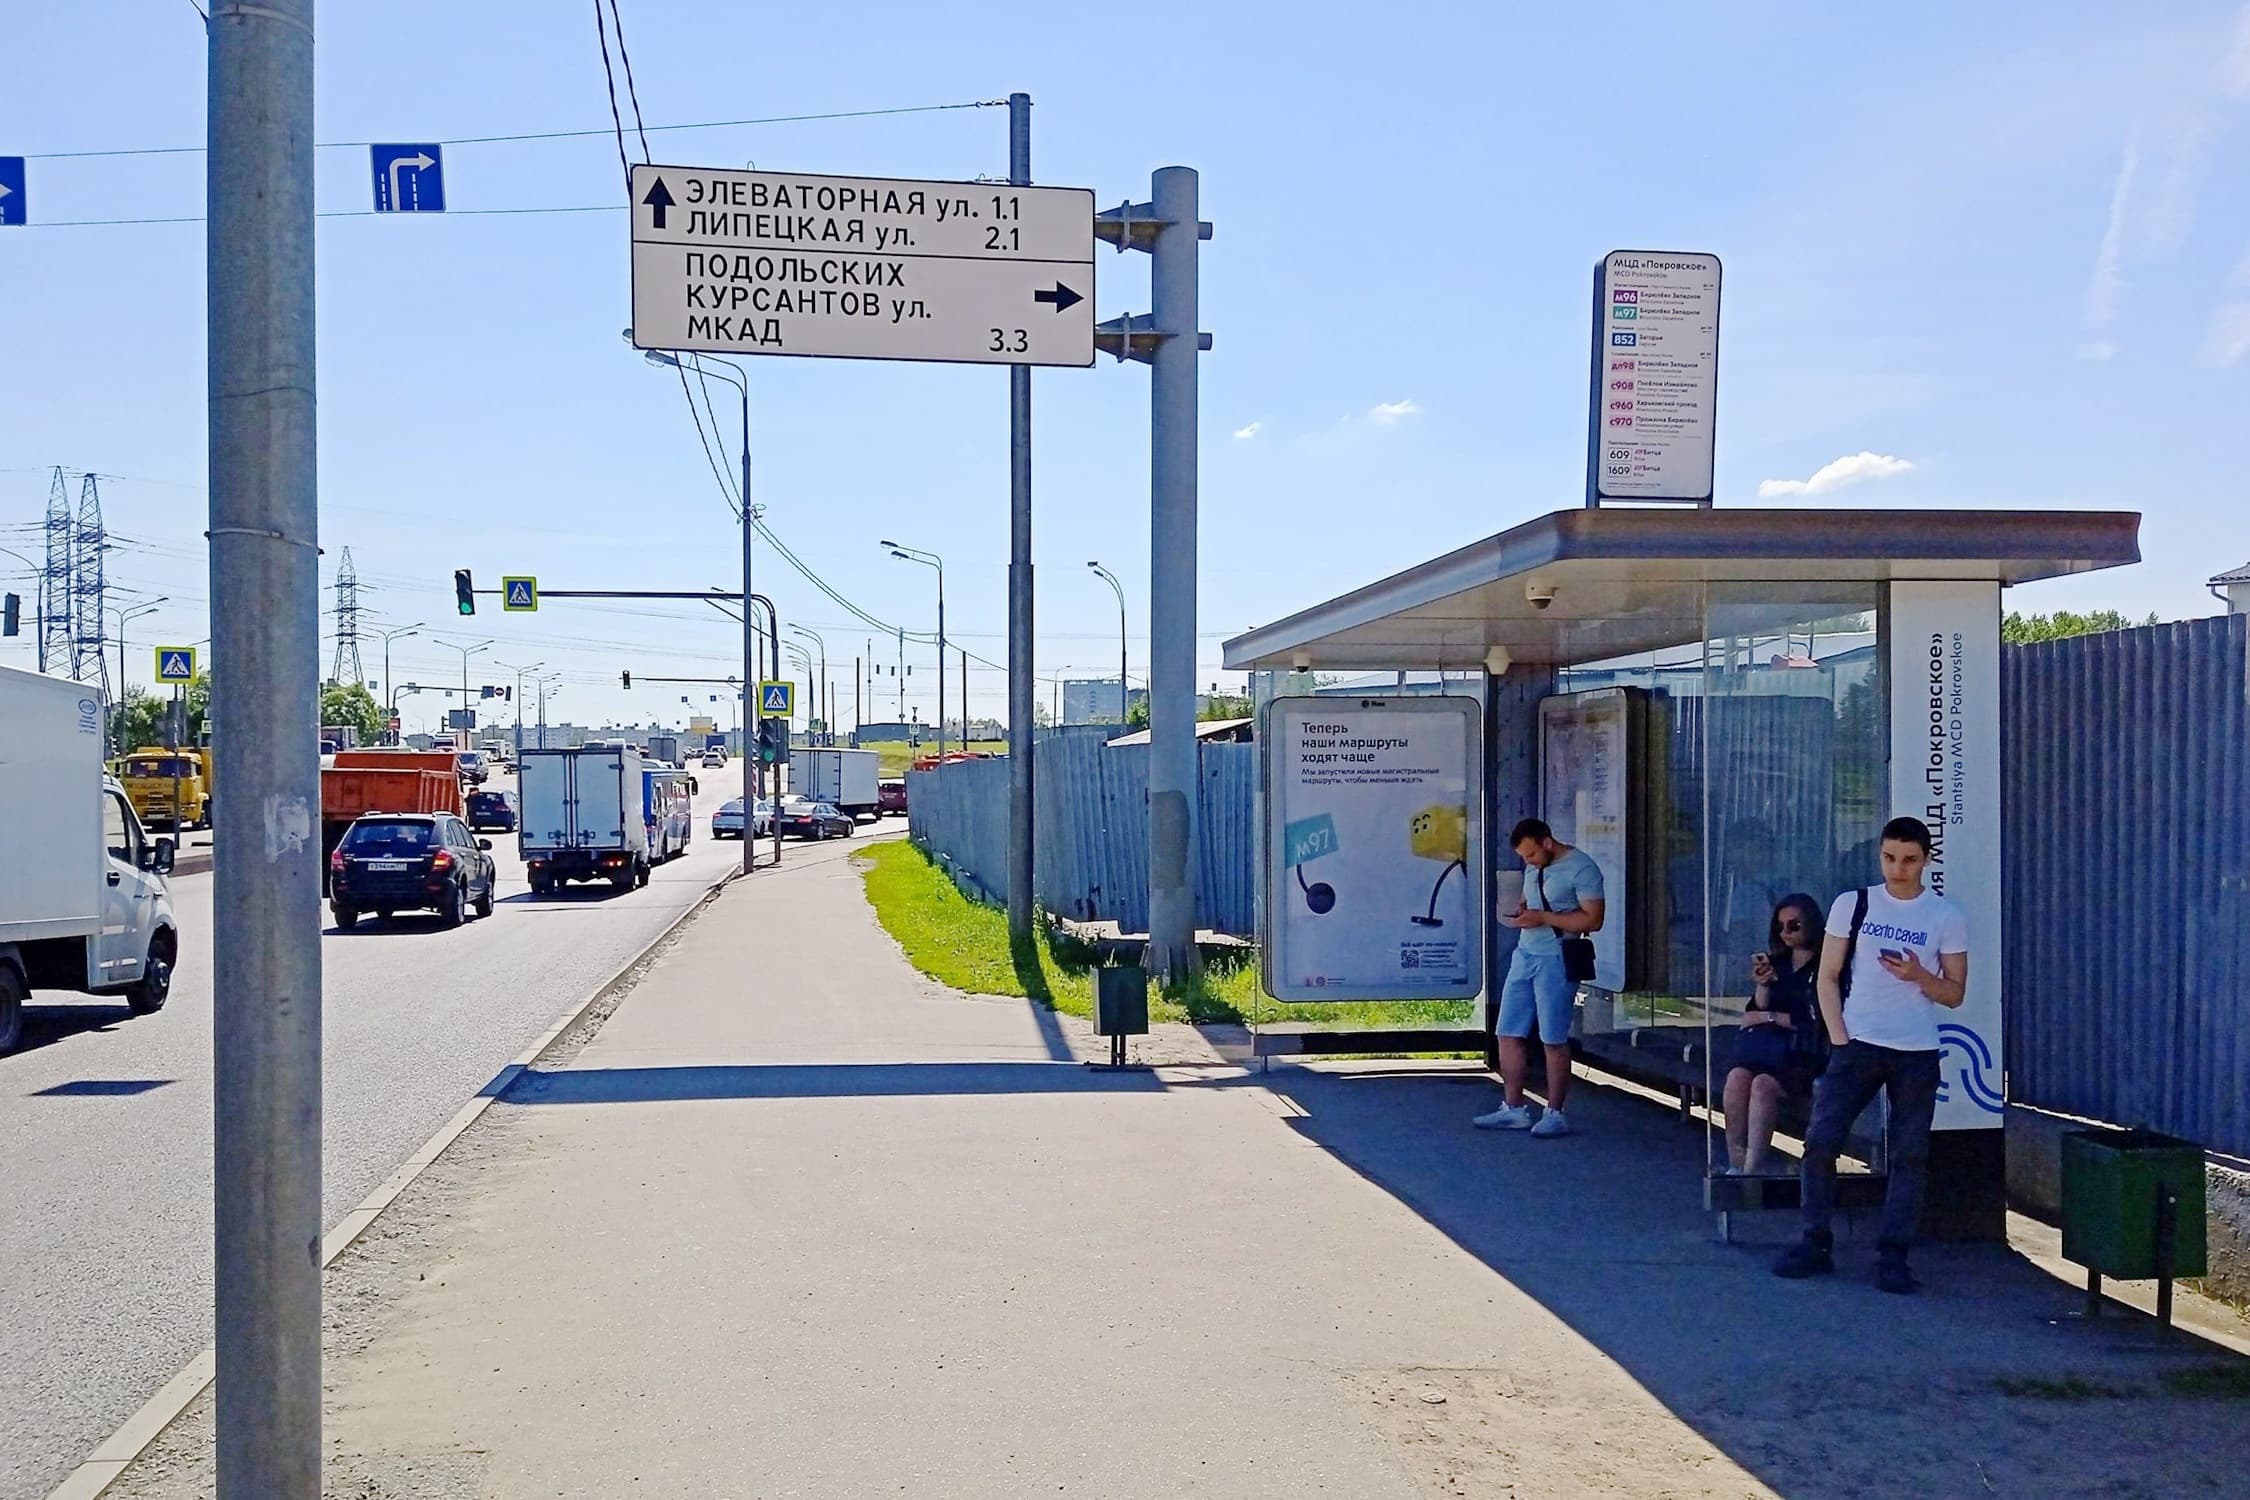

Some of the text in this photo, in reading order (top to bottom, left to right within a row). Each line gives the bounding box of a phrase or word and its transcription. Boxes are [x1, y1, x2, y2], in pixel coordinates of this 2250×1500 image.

[686, 180, 1020, 222] ЭЛЕВАТОРНАЯ ул. 1.1
[687, 211, 1020, 251] ЛИПЕЦКАЯ ул. 2.1
[686, 253, 905, 287] ПОДОЛЬСКИХ
[1613, 259, 1707, 271] МЦД «Покровское»
[687, 284, 932, 323] КУРСАНТОВ ул.
[688, 316, 1030, 353] МКАД 3.3
[1614, 335, 1635, 345] 852
[1610, 450, 1630, 460] 609
[1608, 466, 1630, 475] 1609
[1301, 722, 1348, 736] Теперь
[1950, 633, 1965, 825] Stantsiya MCD Pokrovskoe
[1301, 738, 1409, 750] наши маршруты
[1301, 753, 1375, 764] ходят чаще
[1926, 633, 1947, 897] ия МЦД «Покровское»
[1862, 920, 1895, 939] oberto
